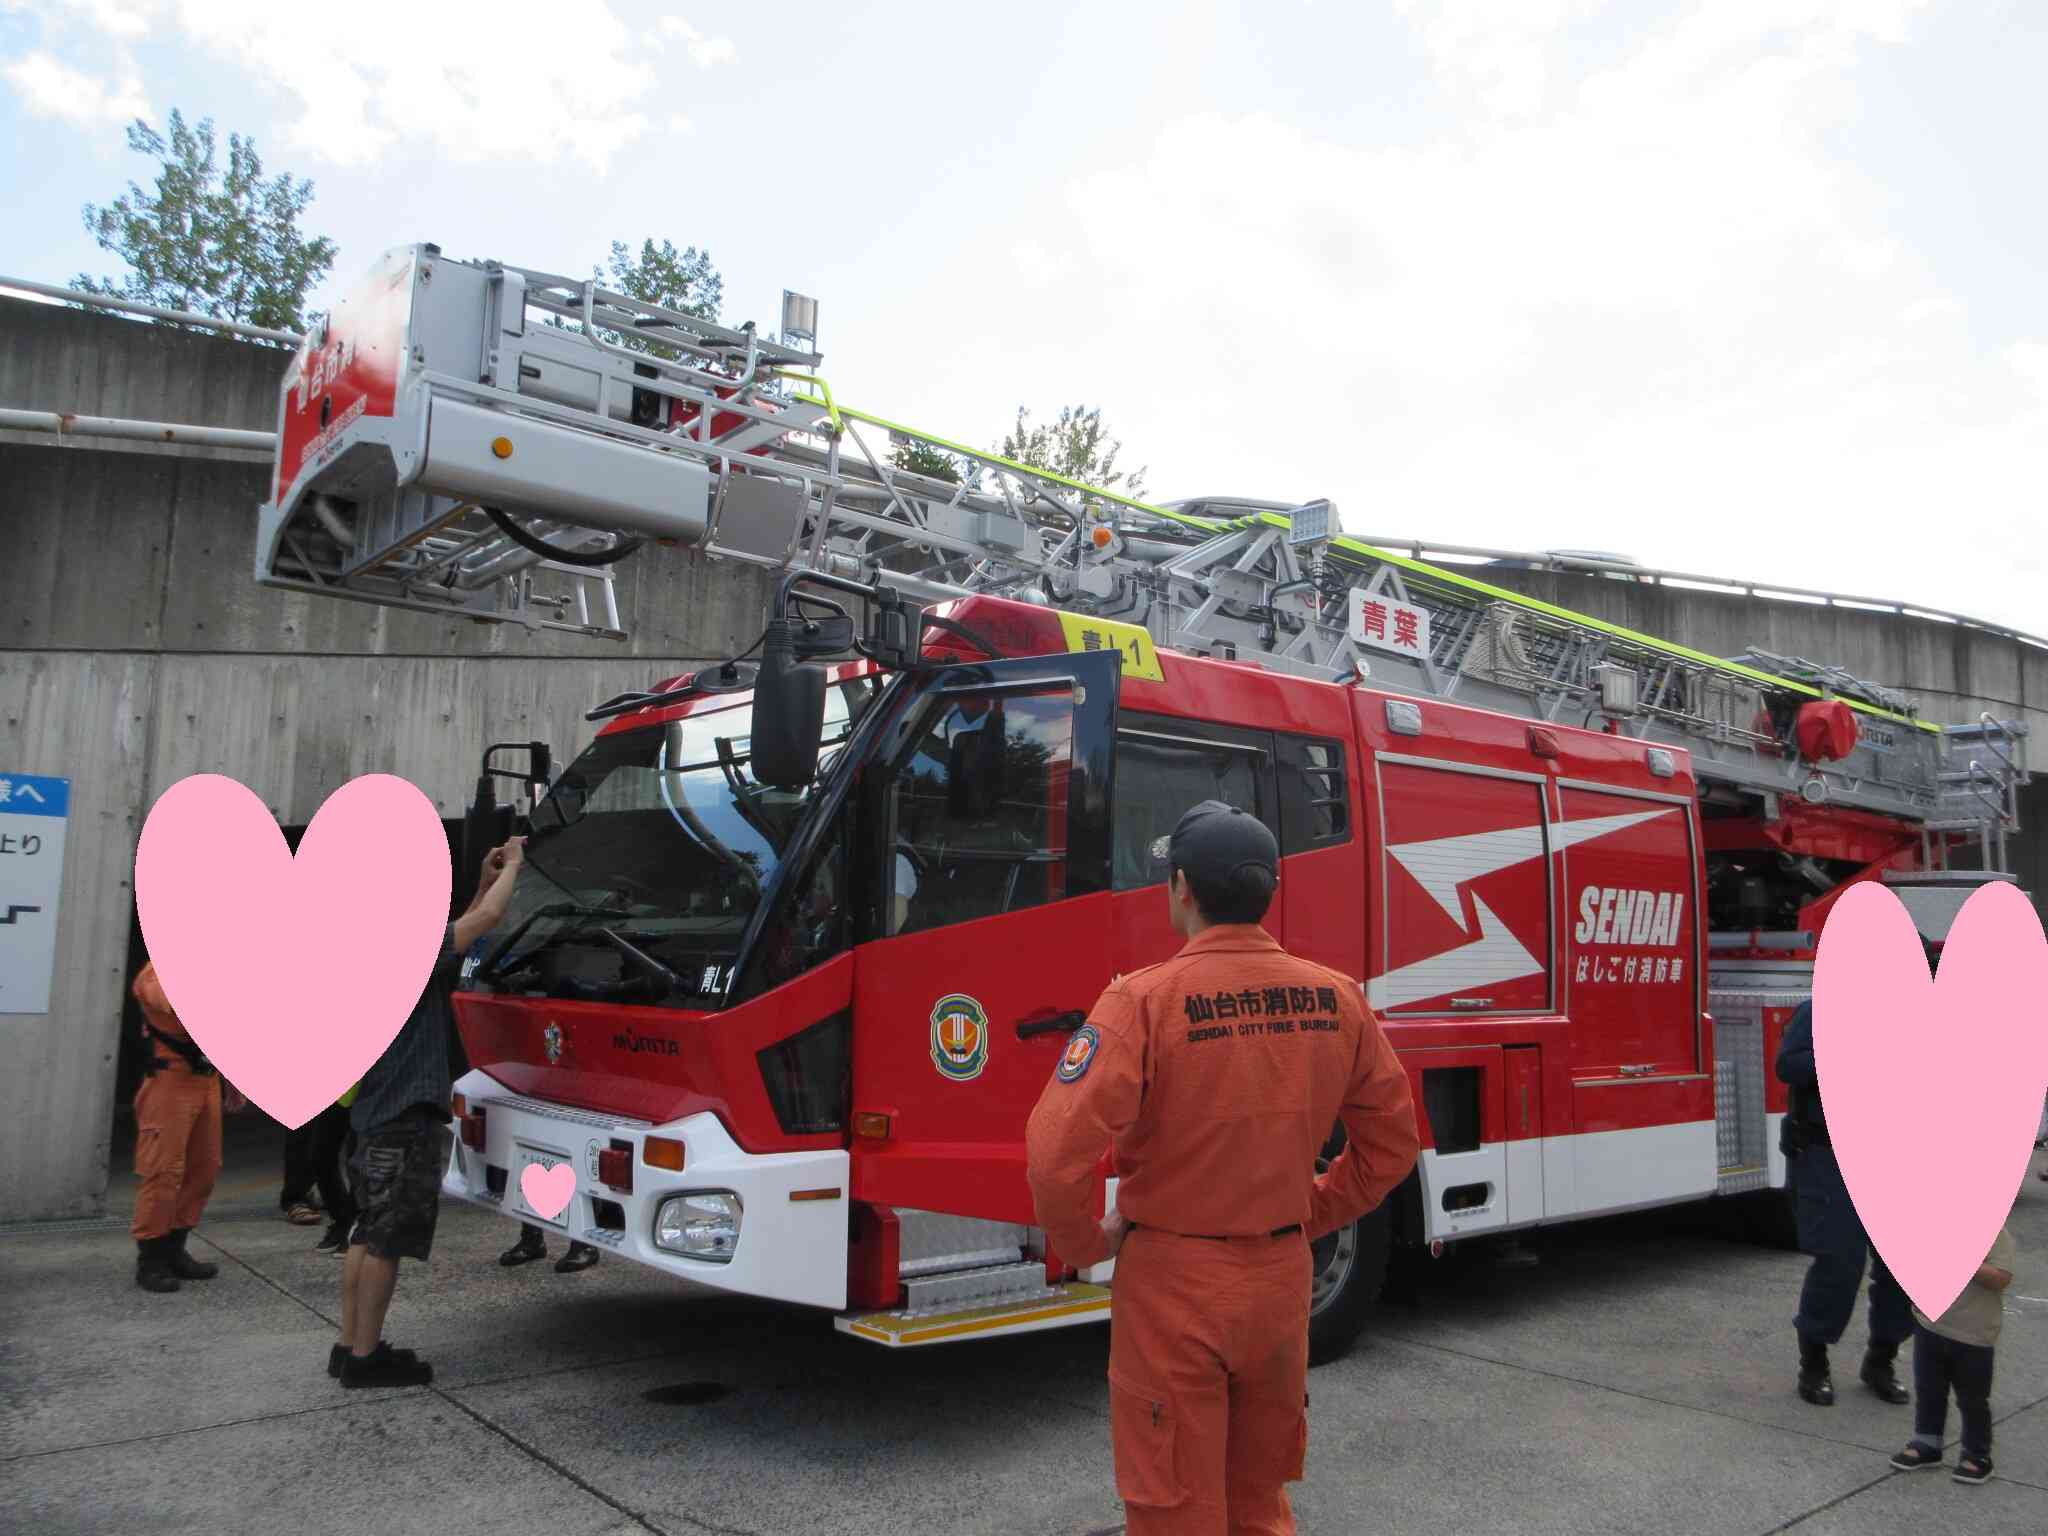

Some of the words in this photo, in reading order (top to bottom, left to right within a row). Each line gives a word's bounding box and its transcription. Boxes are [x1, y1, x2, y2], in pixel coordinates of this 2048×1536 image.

[1361, 600, 1418, 649] 青葉
[1575, 885, 1684, 946] SENDAI
[1576, 955, 1683, 984] はしご付消防車
[1184, 986, 1338, 1025] 仙台市消防局
[1187, 1025, 1233, 1042] SENDAI
[1238, 1022, 1264, 1036] CITY
[1267, 1020, 1295, 1034] FIRE
[1300, 1019, 1340, 1033] BUREAU
